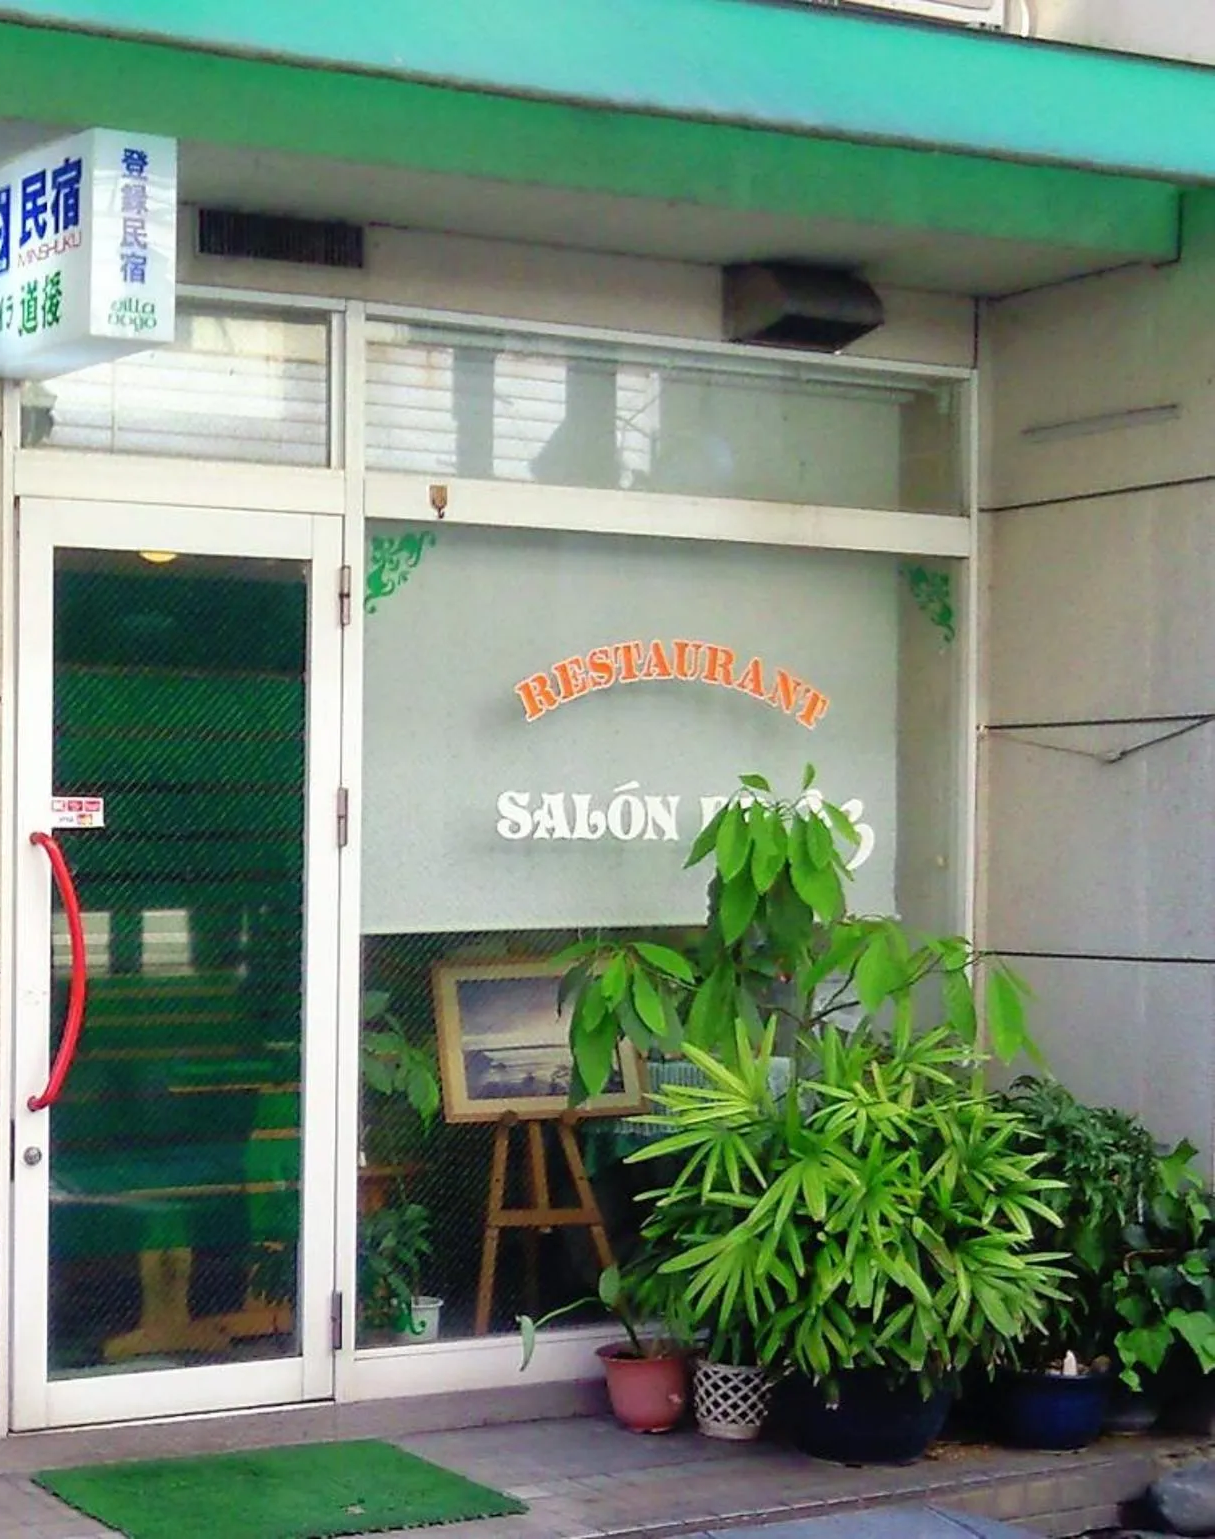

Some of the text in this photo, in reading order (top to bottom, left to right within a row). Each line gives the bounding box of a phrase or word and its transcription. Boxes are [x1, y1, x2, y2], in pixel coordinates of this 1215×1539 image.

[19, 157, 82, 249] 民宿
[17, 232, 82, 268] MINSHUKU
[514, 639, 830, 730] RESTAURANT
[496, 780, 680, 841] SALÓN
